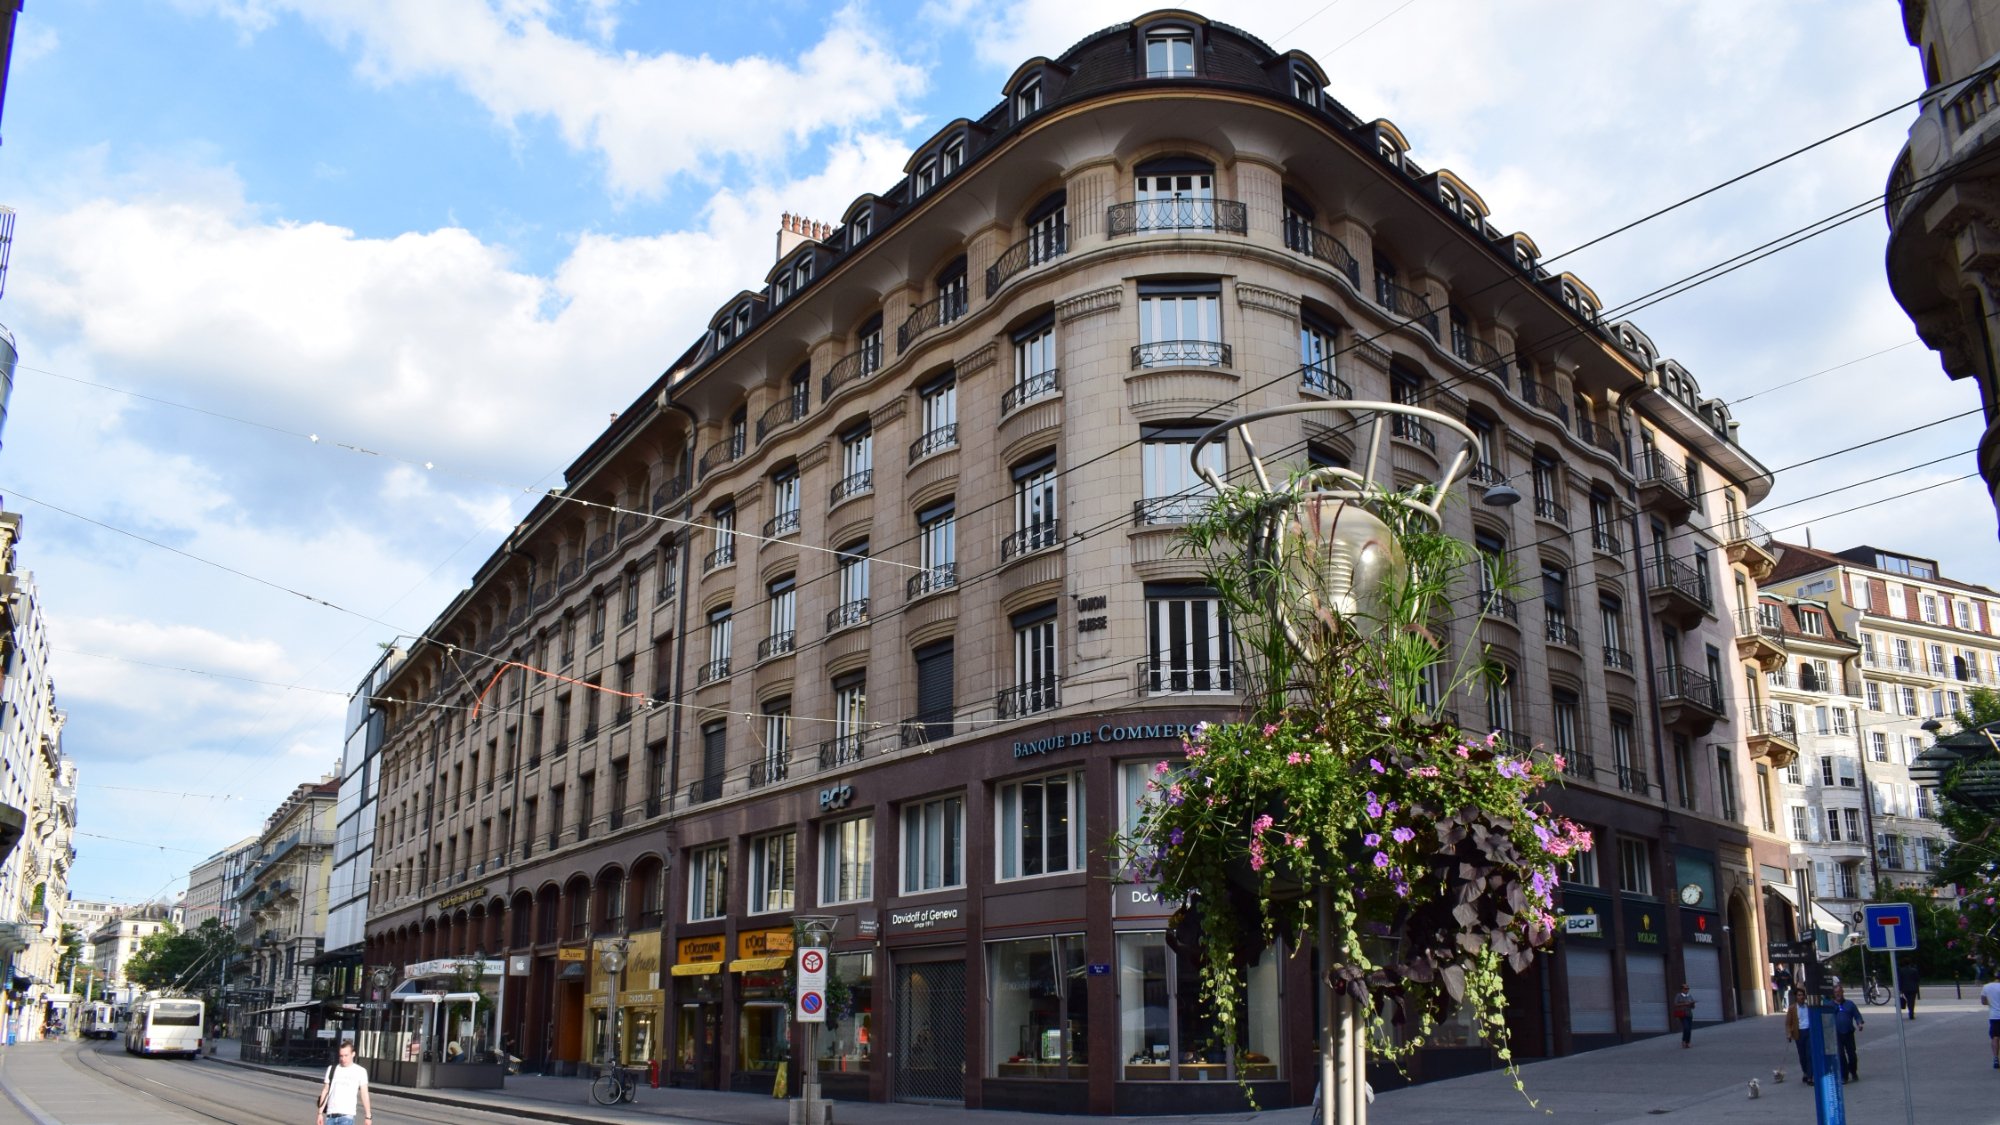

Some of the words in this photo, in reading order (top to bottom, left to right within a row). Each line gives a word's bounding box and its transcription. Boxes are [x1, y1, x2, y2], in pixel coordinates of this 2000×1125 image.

[1077, 595, 1106, 612] UNION
[1078, 616, 1107, 632] SUISSE
[1013, 735, 1065, 758] BANQUE
[1071, 730, 1092, 746] DE
[820, 785, 852, 811] BCP
[892, 911, 920, 924] Davidoff
[921, 910, 929, 921] of
[929, 909, 957, 920] Geneva
[1568, 919, 1594, 929] BCP
[1694, 932, 1712, 943] TUDOR
[563, 949, 582, 958] Auer
